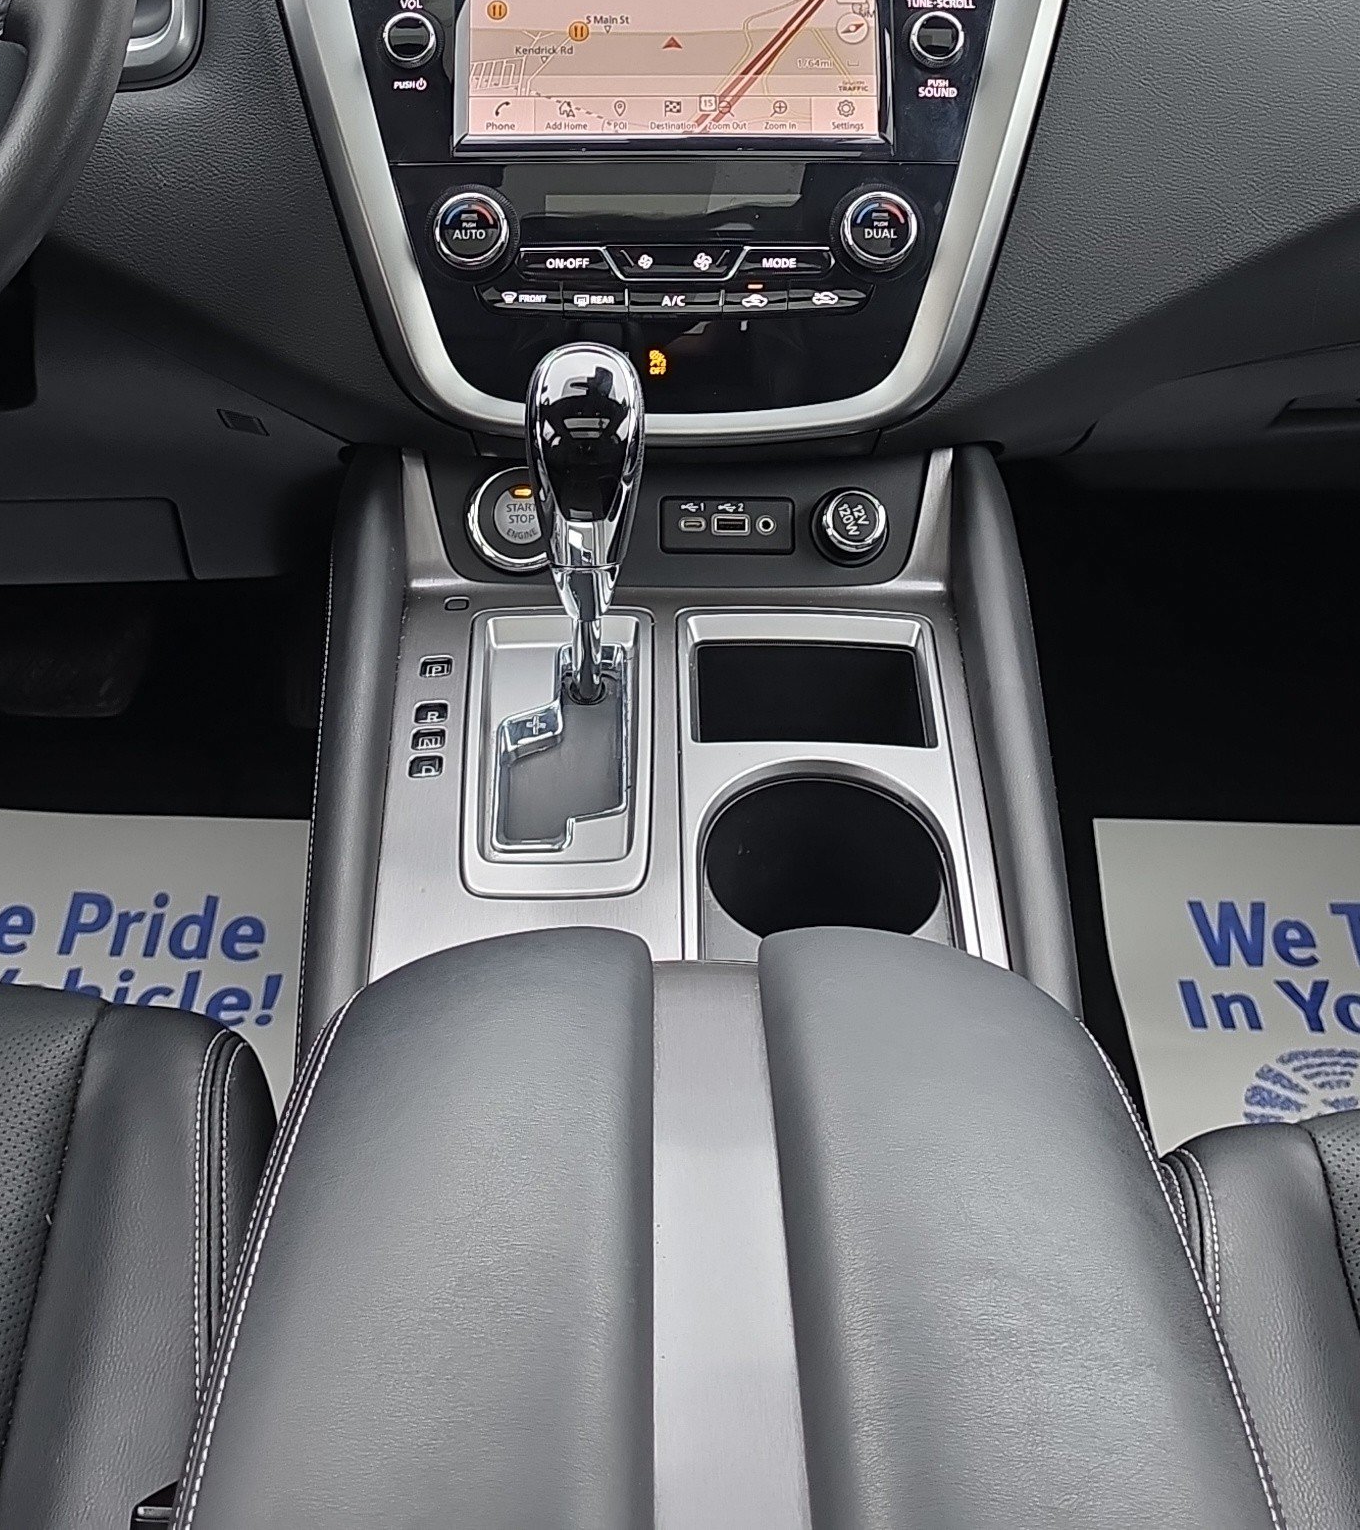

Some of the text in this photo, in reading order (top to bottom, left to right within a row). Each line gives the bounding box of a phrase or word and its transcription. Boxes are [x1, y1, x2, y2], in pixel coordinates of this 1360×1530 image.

[400, 0, 423, 9] VOL
[594, 15, 618, 24] Main
[620, 15, 629, 24] St
[515, 45, 573, 55] Kendrick Rd
[797, 58, 833, 68] 1/64mi
[393, 80, 415, 90] PUSH
[918, 87, 958, 98] SOUND
[703, 99, 713, 107] 15
[486, 122, 515, 131] Phone
[545, 122, 588, 131] Add Home
[650, 122, 697, 131] Destination
[707, 122, 747, 130] Zoom Out
[764, 122, 796, 130] Zoom In
[832, 122, 864, 132] Settings
[452, 229, 486, 240] AUTO
[864, 228, 897, 239] DUAL
[762, 257, 797, 269] MODE
[519, 295, 547, 303] FRONT
[590, 295, 615, 304] REAR
[661, 295, 686, 307] A/C
[649, 366, 666, 375] OFF
[737, 503, 744, 511] 2
[508, 514, 535, 524] STOP
[837, 503, 860, 536] 120W
[852, 504, 869, 526] 12V
[506, 527, 539, 539] ENGINE
[431, 665, 442, 676] P
[427, 711, 438, 722] R
[423, 738, 436, 749] N
[421, 765, 436, 776] D
[56, 891, 268, 963] Pride
[1187, 899, 1318, 968] We
[1178, 979, 1262, 1031] In
